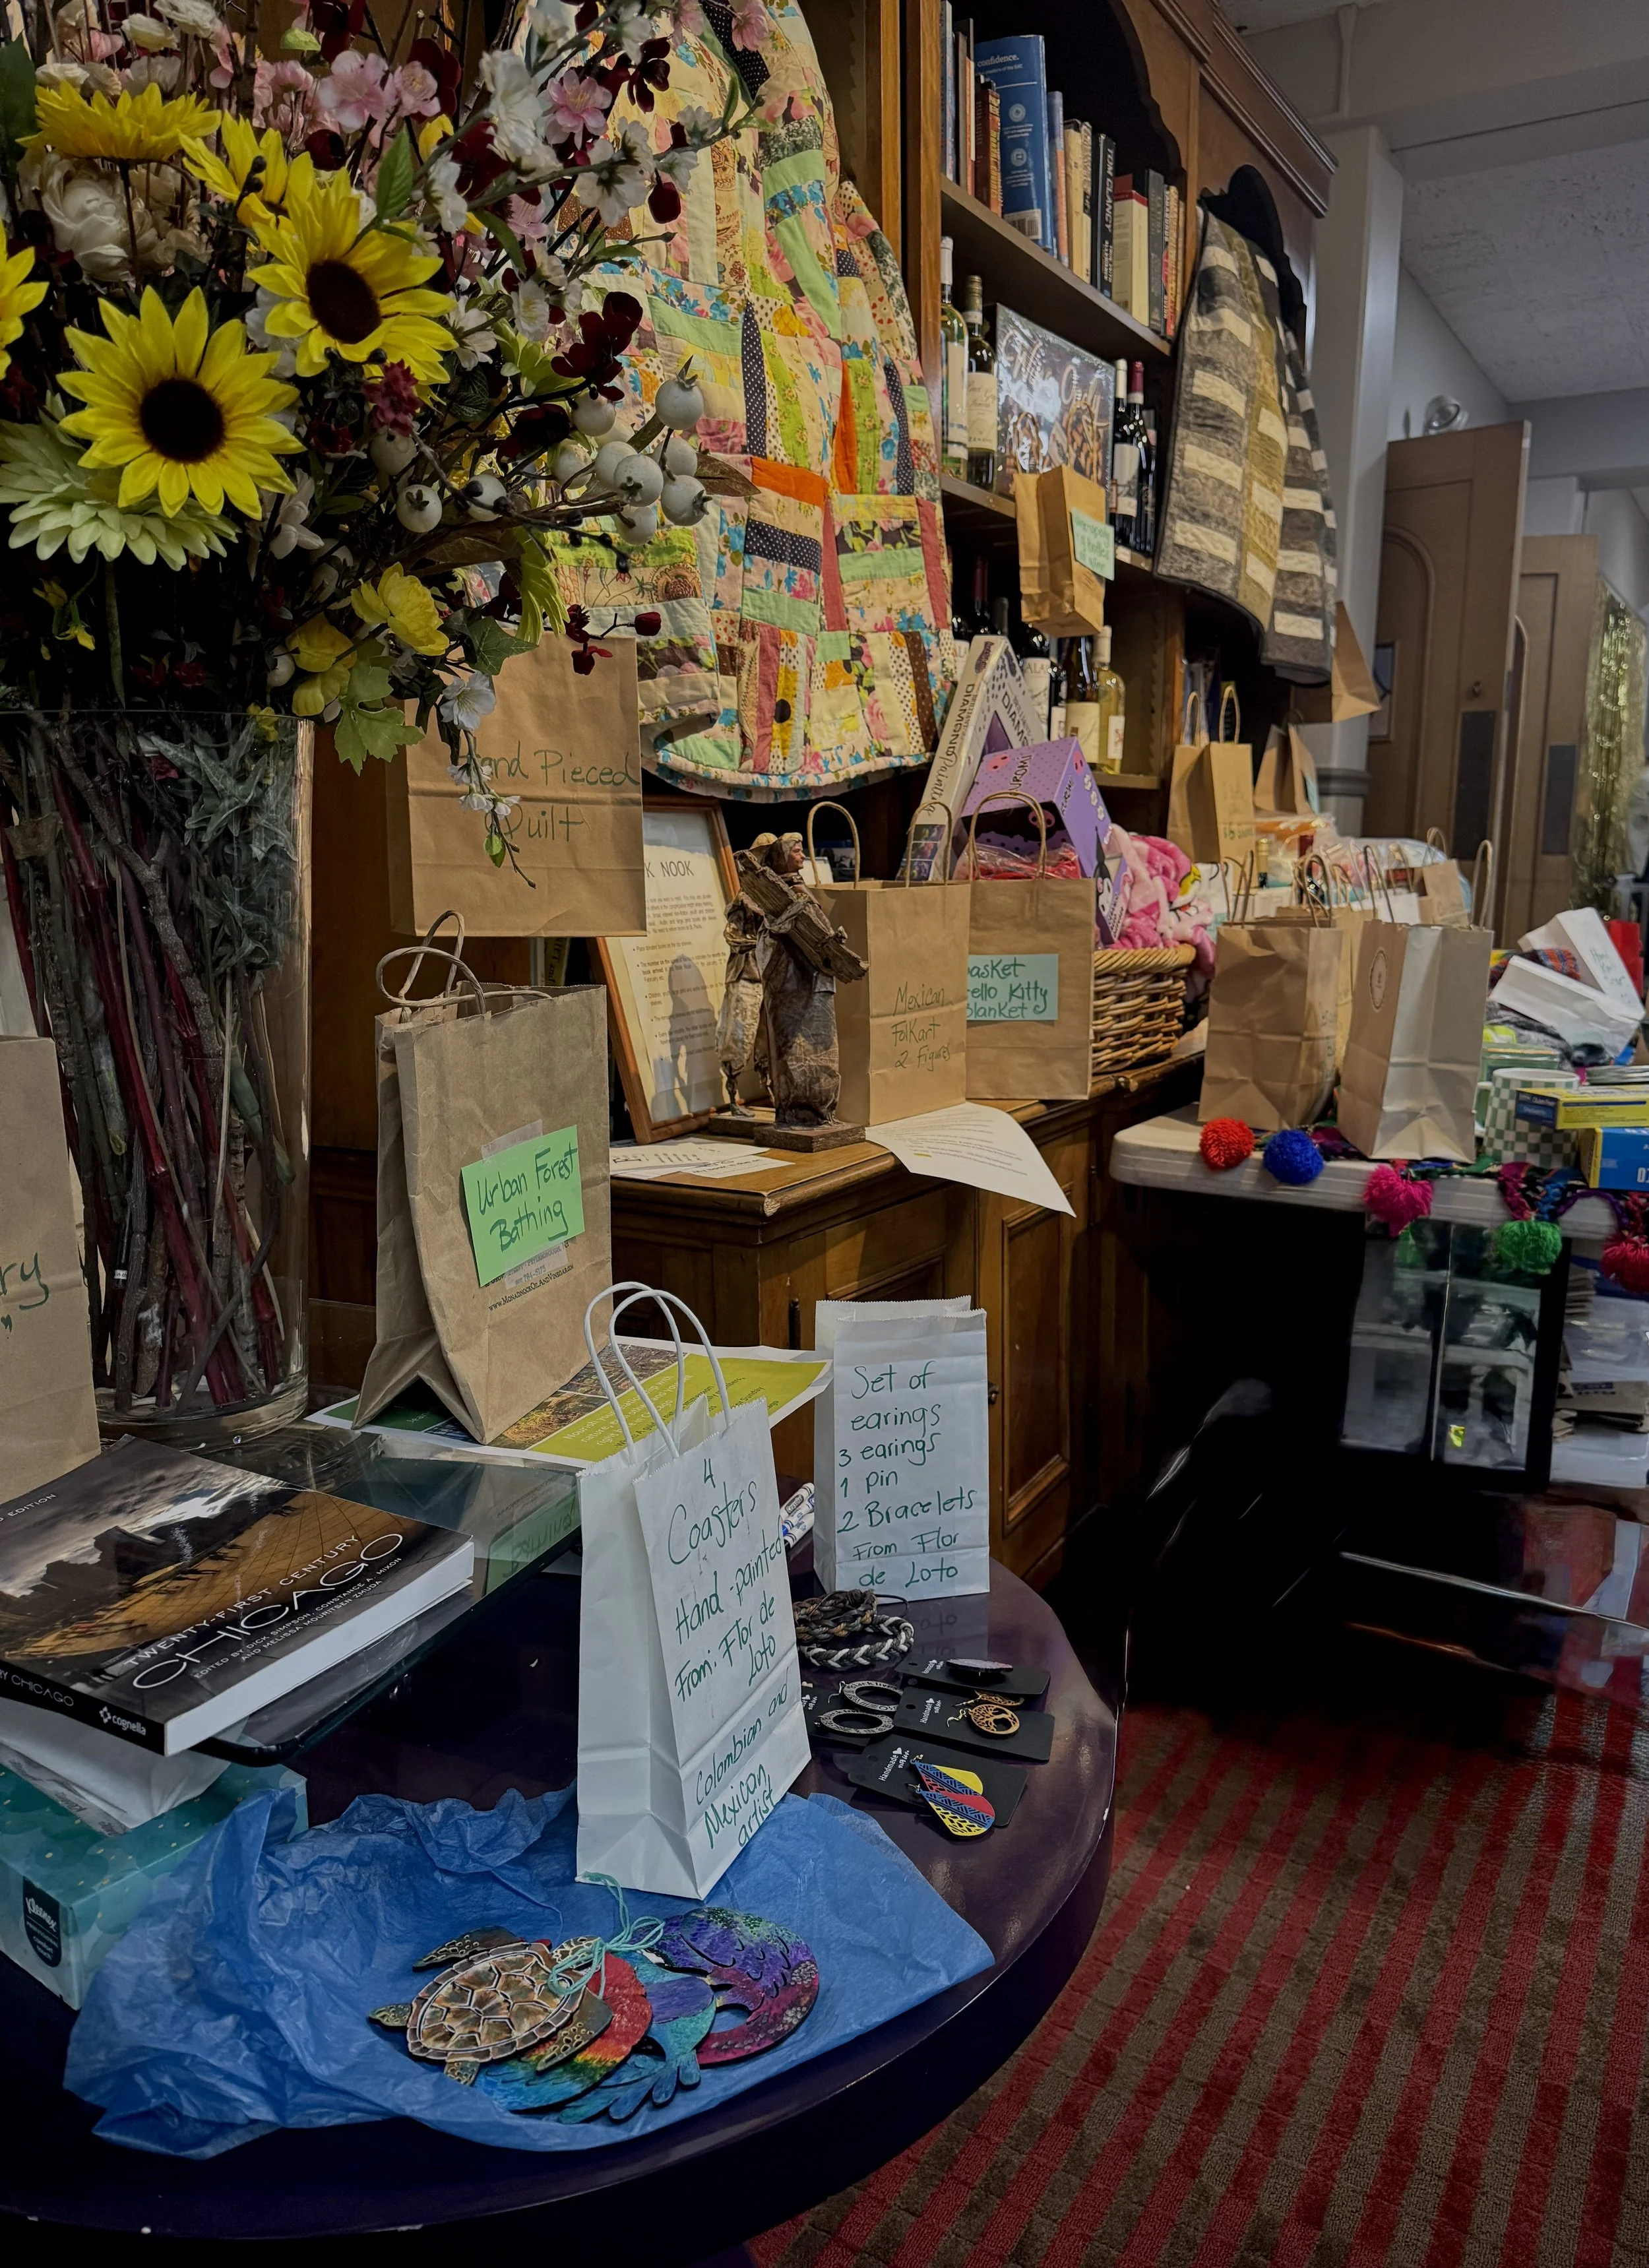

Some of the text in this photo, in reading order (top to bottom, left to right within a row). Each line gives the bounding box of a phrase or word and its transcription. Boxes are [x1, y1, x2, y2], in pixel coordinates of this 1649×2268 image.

[977, 54, 1019, 67] confidence.
[1104, 179, 1114, 233] CLANCY
[947, 683, 975, 757] DIAMOND
[534, 749, 640, 787] Pieced
[485, 803, 584, 842] Quilt
[660, 860, 695, 877] NOOK
[892, 980, 945, 1017] Mexican
[1009, 979, 1048, 1015] Kitty
[894, 1050, 909, 1069] 2
[477, 1142, 578, 1215] Urban Forest
[489, 1195, 569, 1253] Bathing
[851, 1360, 937, 1399] Set of
[562, 1419, 597, 1441] Nourish
[656, 1375, 674, 1387] with
[851, 1404, 942, 1438] earings
[838, 1432, 942, 1468] 3 earings
[704, 1457, 716, 1489] 4
[840, 1476, 849, 1498] 1
[7, 1494, 57, 1517] EDITION
[668, 1480, 757, 1565] Coasters
[836, 1510, 860, 1534] 2
[865, 1486, 978, 1528] Bracelets
[853, 1526, 960, 1561] From Flor
[859, 1557, 959, 1588] de Loto
[123, 1534, 359, 1667] TWENTY-FIRST CENTURY
[132, 1532, 404, 1690] CHICAGO
[194, 1657, 230, 1680] EDITED
[230, 1647, 246, 1659] BY
[245, 1635, 270, 1651] DICK
[269, 1610, 316, 1636] SIMPSON,
[314, 1582, 365, 1612] CONSTANCE
[376, 1556, 403, 1578] MIXON
[240, 1579, 384, 1663] AND MELISSA MOURITSEN ZMUDA
[718, 1616, 753, 1668] Flor
[759, 1590, 775, 1625] de
[749, 1631, 777, 1688] Loto
[11, 1674, 75, 1707] CHICAGO
[112, 1714, 146, 1736] cognella
[919, 1703, 934, 1724] Handmade
[696, 1666, 790, 1806] Colombian and
[878, 1754, 899, 1782] Handmade
[704, 1763, 767, 1850] Mexican
[738, 1773, 776, 1848] artist
[25, 1897, 57, 1933] Kleenex
